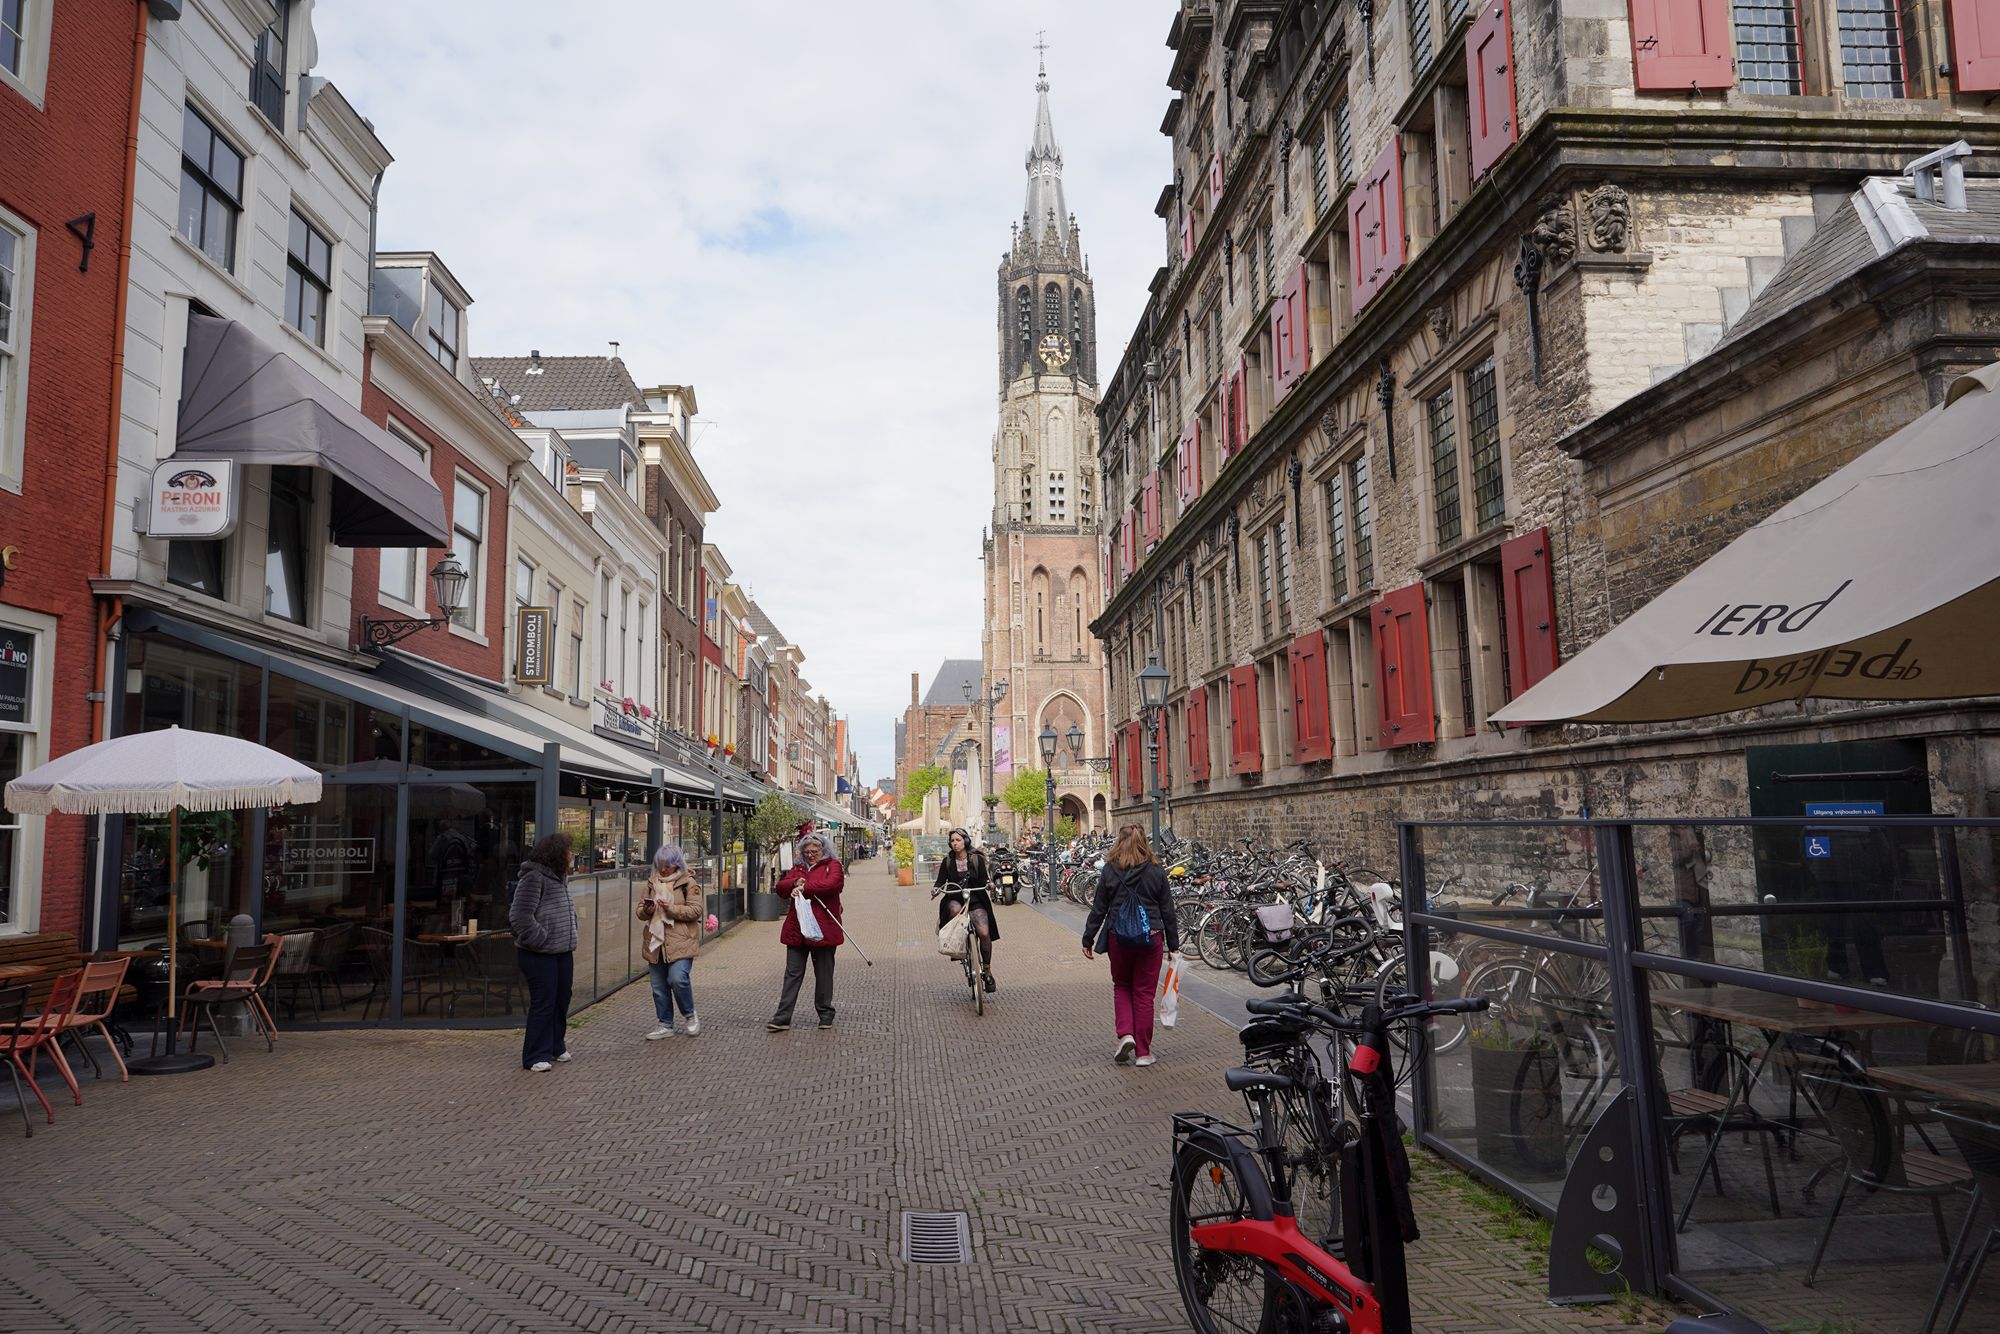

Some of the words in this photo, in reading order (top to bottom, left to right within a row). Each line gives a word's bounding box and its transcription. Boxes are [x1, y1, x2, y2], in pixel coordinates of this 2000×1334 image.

[161, 491, 221, 505] PERONI
[525, 614, 537, 676] STROMBOLI
[290, 847, 367, 858] STROMBOLI
